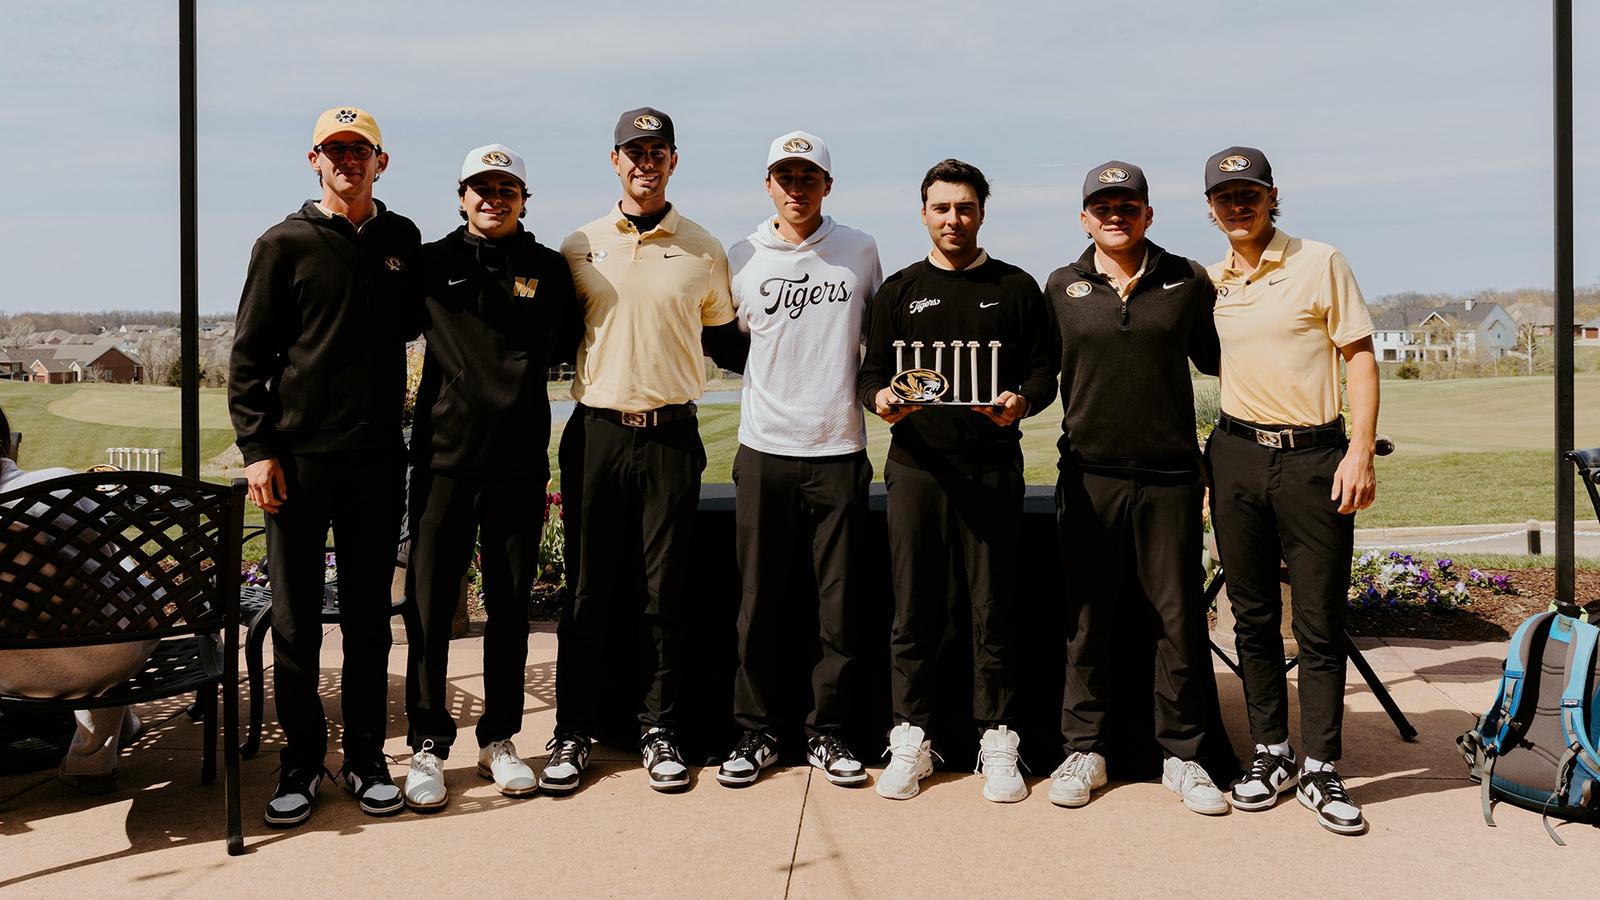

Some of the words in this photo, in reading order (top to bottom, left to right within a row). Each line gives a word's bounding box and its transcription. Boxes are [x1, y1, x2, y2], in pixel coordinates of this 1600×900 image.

[513, 276, 539, 298] M
[760, 273, 852, 319] Tigers
[909, 297, 941, 314] Tigers
